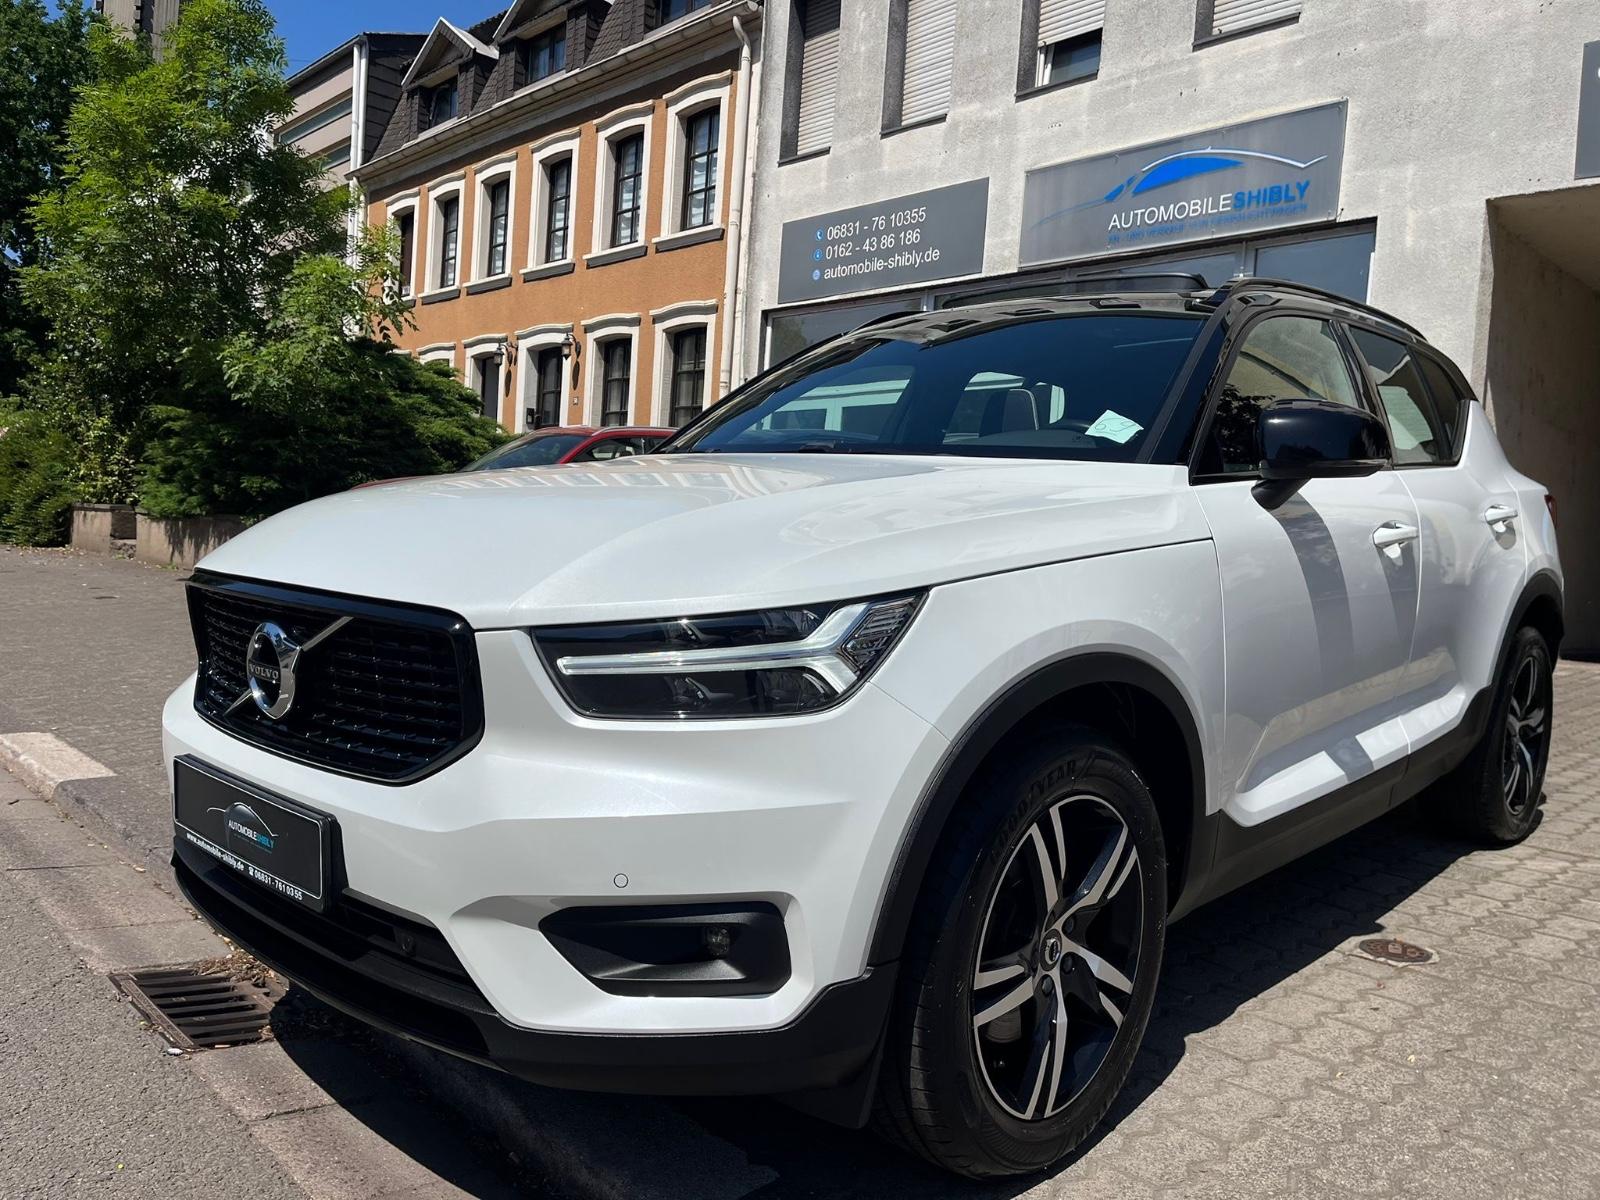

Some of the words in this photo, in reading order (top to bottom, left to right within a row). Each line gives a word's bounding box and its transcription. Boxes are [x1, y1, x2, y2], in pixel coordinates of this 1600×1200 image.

[827, 221, 860, 240] 06831
[871, 216, 886, 231] 76
[890, 207, 926, 227] 10355
[826, 243, 852, 259] 0162
[862, 237, 877, 252] 43
[880, 234, 895, 249] 86
[899, 228, 921, 246] 186
[824, 247, 940, 279] automobile-shibly.de
[249, 663, 279, 680] VOLVO
[254, 869, 272, 885] 06831
